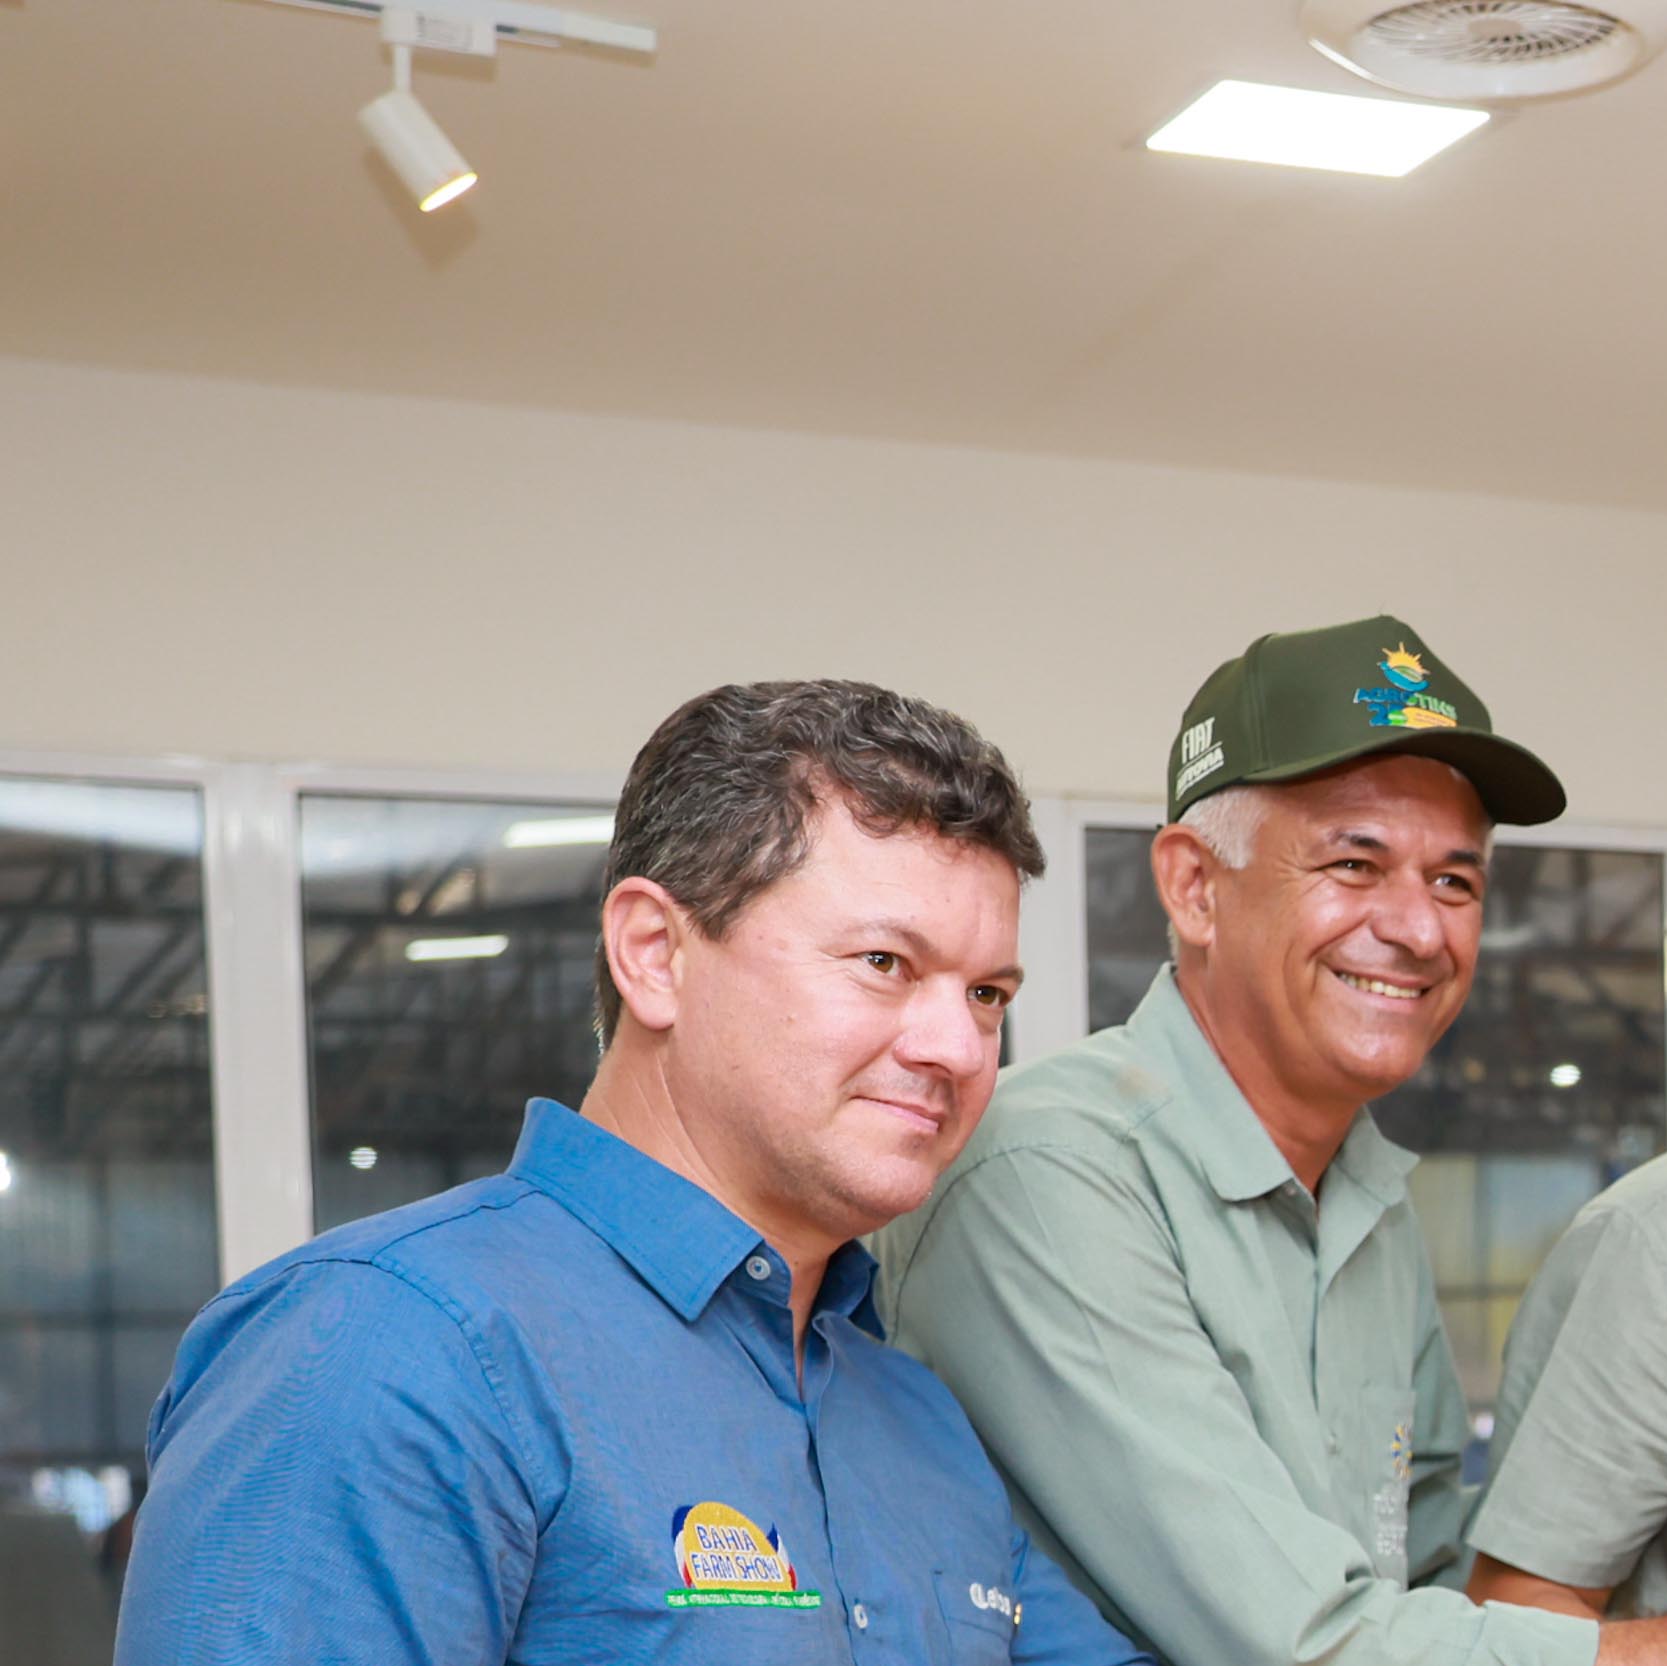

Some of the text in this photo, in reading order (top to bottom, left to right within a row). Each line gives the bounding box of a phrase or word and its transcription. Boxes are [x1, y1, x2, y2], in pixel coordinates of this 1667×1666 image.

[1182, 716, 1215, 765] FIAT
[696, 1525, 758, 1552] BAHIA
[691, 1552, 781, 1580] FARM SHOW
